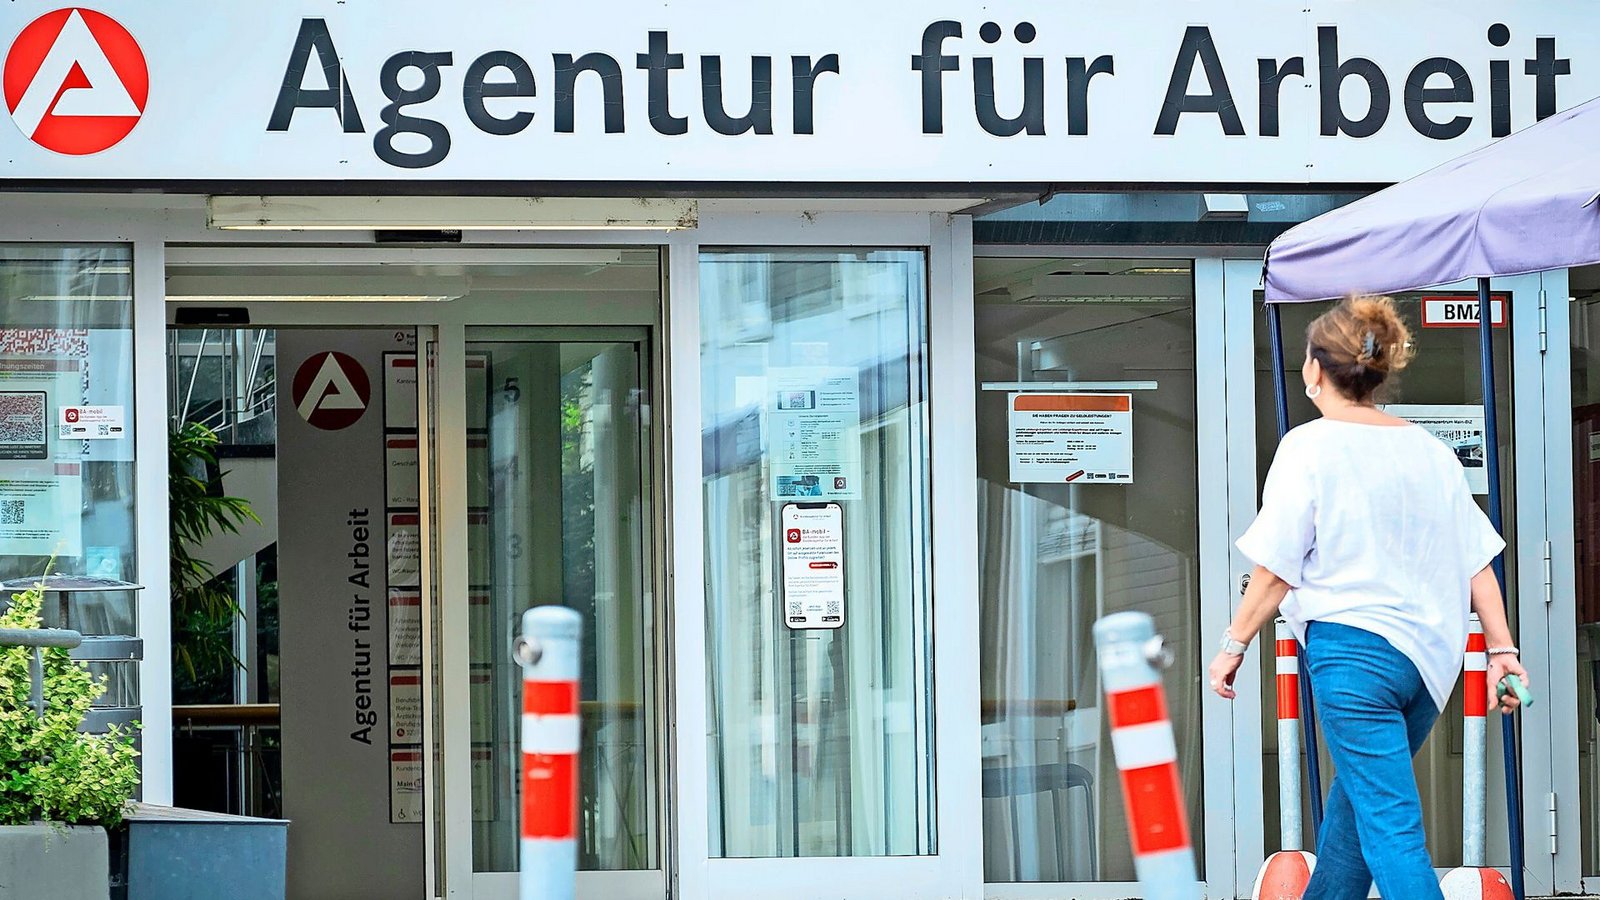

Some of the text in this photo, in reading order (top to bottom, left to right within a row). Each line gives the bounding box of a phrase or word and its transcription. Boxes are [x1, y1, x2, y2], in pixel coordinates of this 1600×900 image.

[266, 18, 1570, 168] Agentur für Arbeit
[348, 508, 377, 745] Agentur für Arbeit
